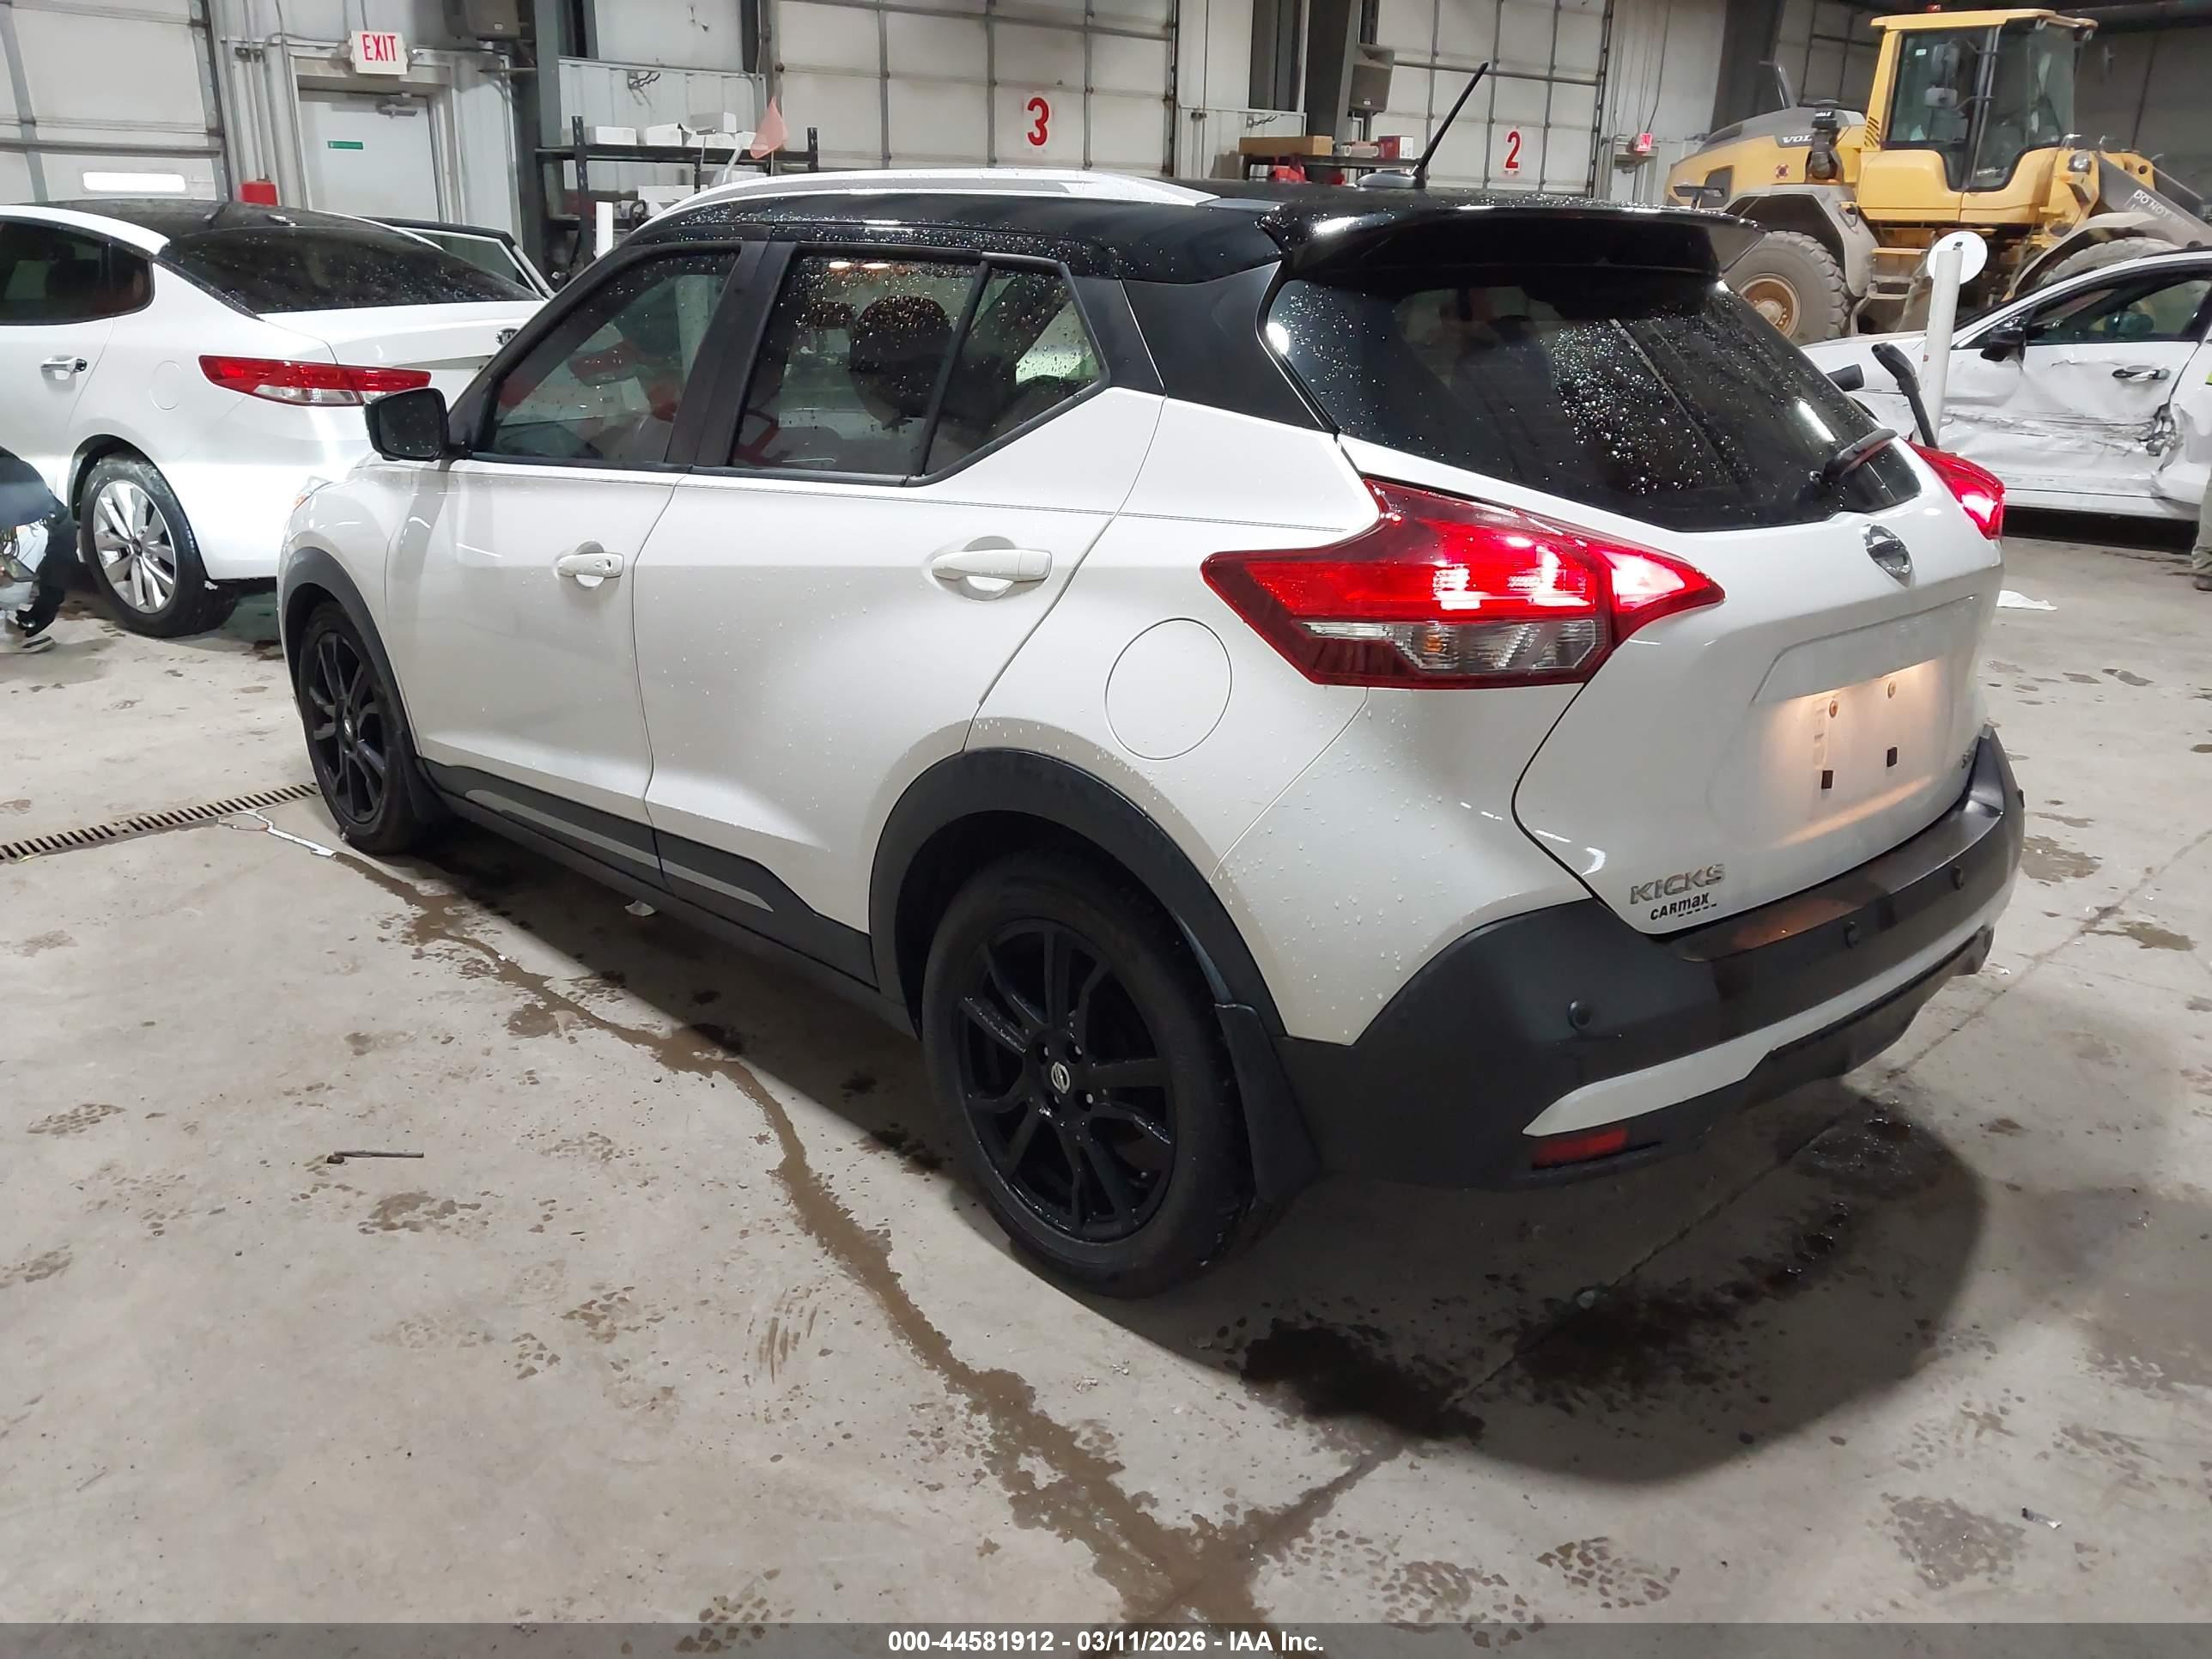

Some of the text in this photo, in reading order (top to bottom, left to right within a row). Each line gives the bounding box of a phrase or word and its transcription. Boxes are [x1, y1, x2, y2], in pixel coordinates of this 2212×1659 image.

[362, 33, 397, 62] EXIT
[1027, 97, 1049, 146] 3
[1505, 131, 1521, 169] 2
[1782, 134, 1814, 143] VOL
[2133, 189, 2149, 204] DO
[1630, 864, 1725, 905] KICKS
